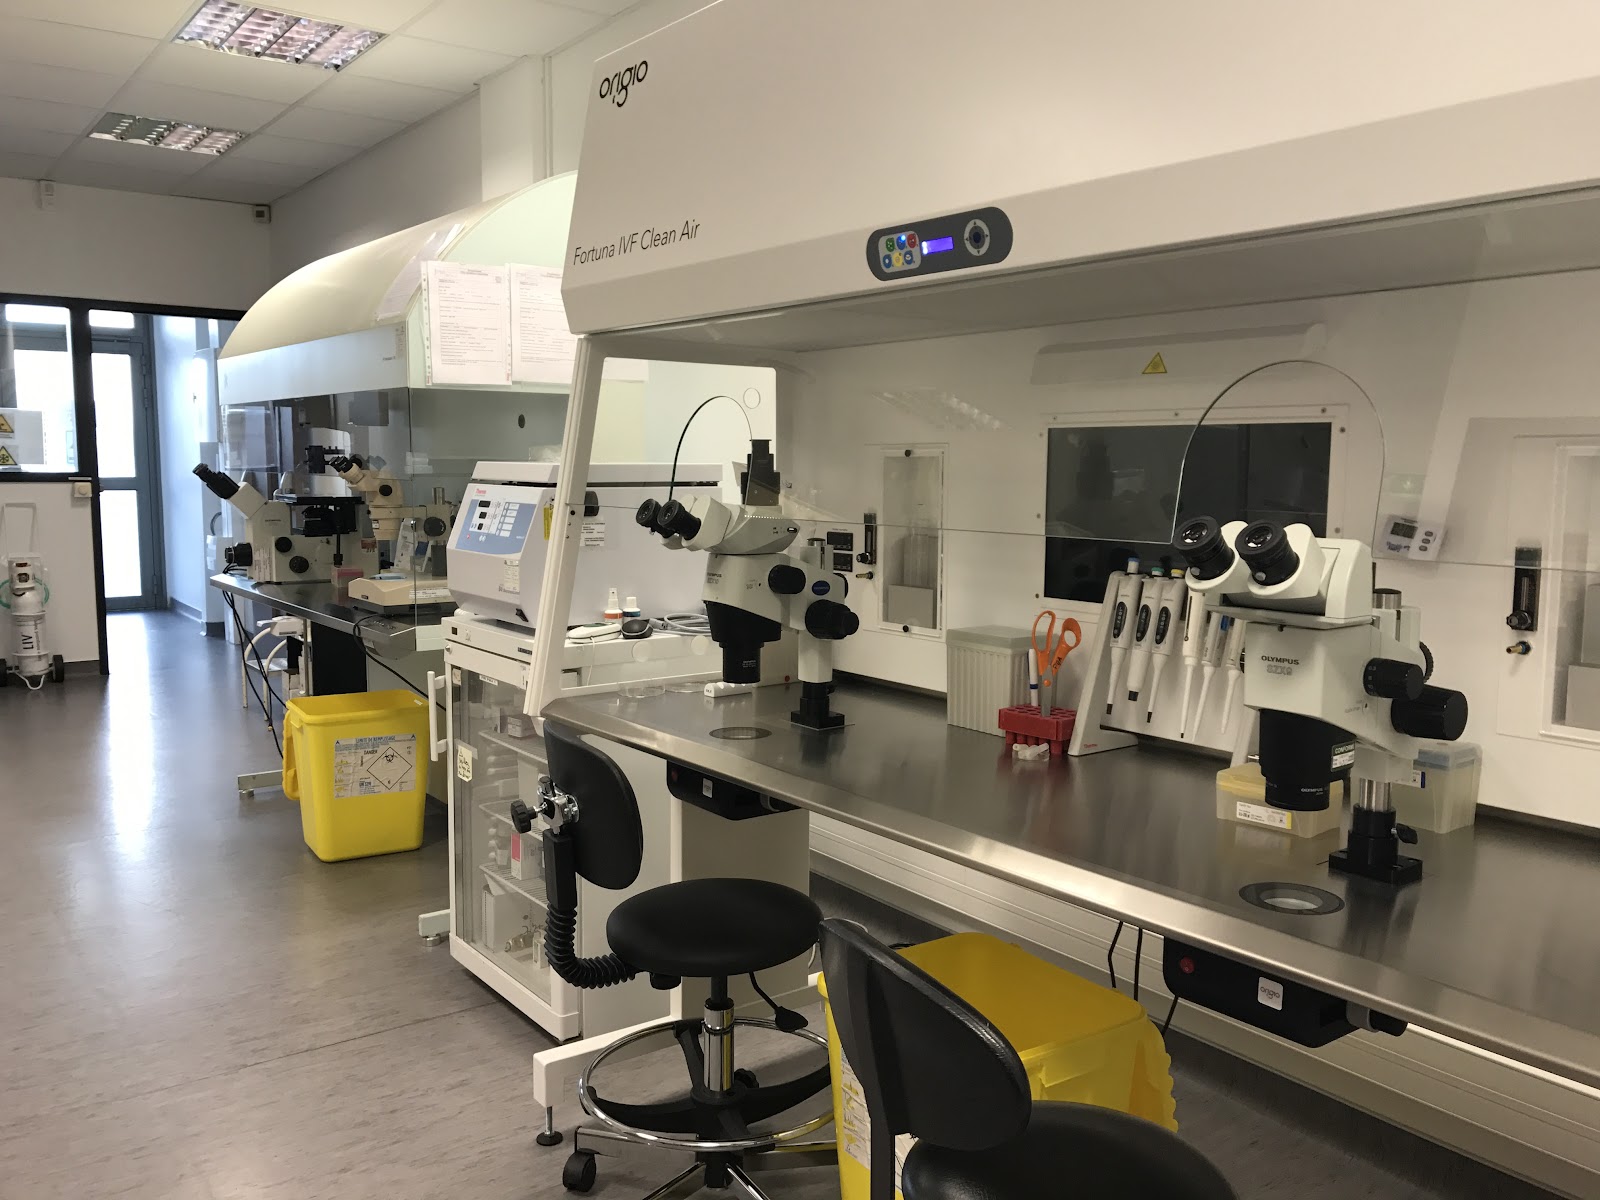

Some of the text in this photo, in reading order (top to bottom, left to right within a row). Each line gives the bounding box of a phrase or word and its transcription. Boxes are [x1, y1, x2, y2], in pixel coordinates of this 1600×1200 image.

[599, 60, 648, 107] origio
[573, 219, 701, 265] Fortuna IVF Clean Air
[1261, 655, 1300, 666] OLYMPUS
